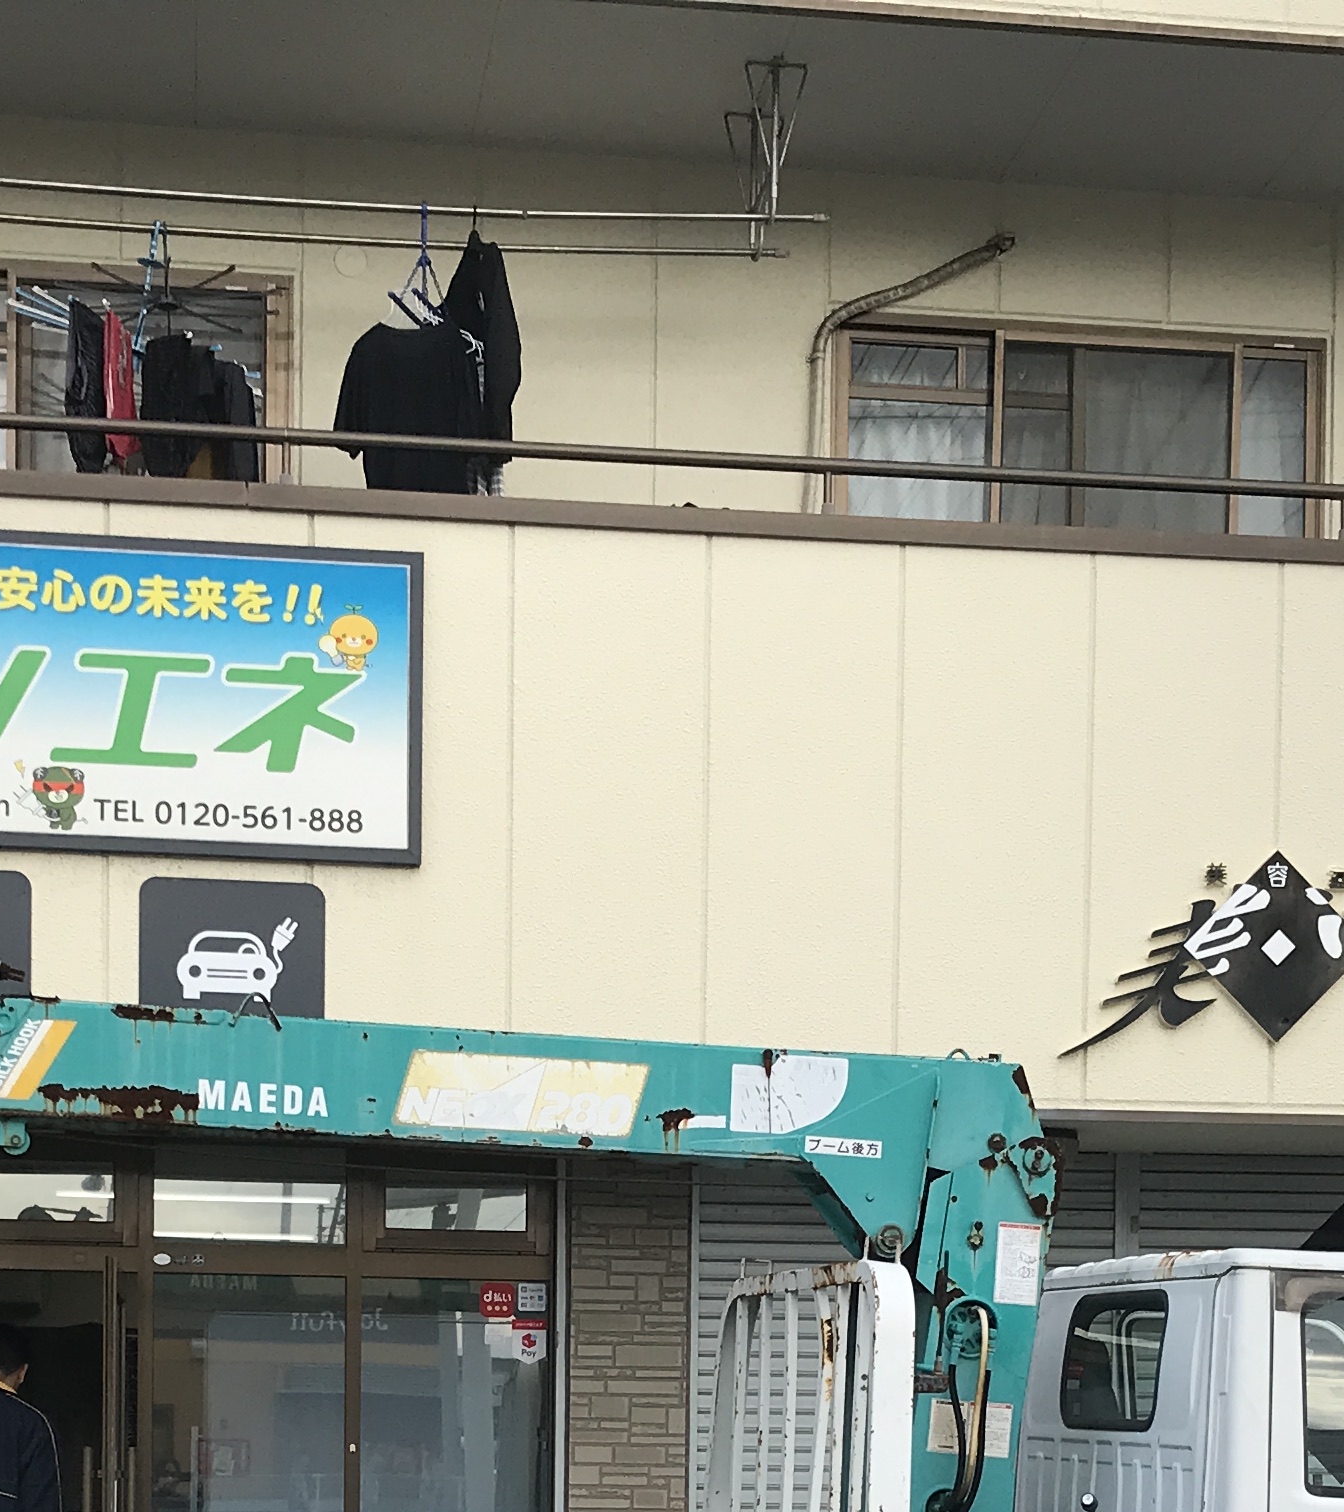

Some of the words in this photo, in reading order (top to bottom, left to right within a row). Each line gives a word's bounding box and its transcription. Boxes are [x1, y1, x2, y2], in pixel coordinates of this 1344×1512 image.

[95, 798, 144, 824] TEL
[154, 801, 364, 834] 0120-561-888
[7, 1018, 41, 1056] HOOK
[197, 1078, 329, 1118] MAEDA
[536, 1089, 633, 1135] 280
[807, 1138, 880, 1158] ブーム後方
[483, 1290, 512, 1303] d払い
